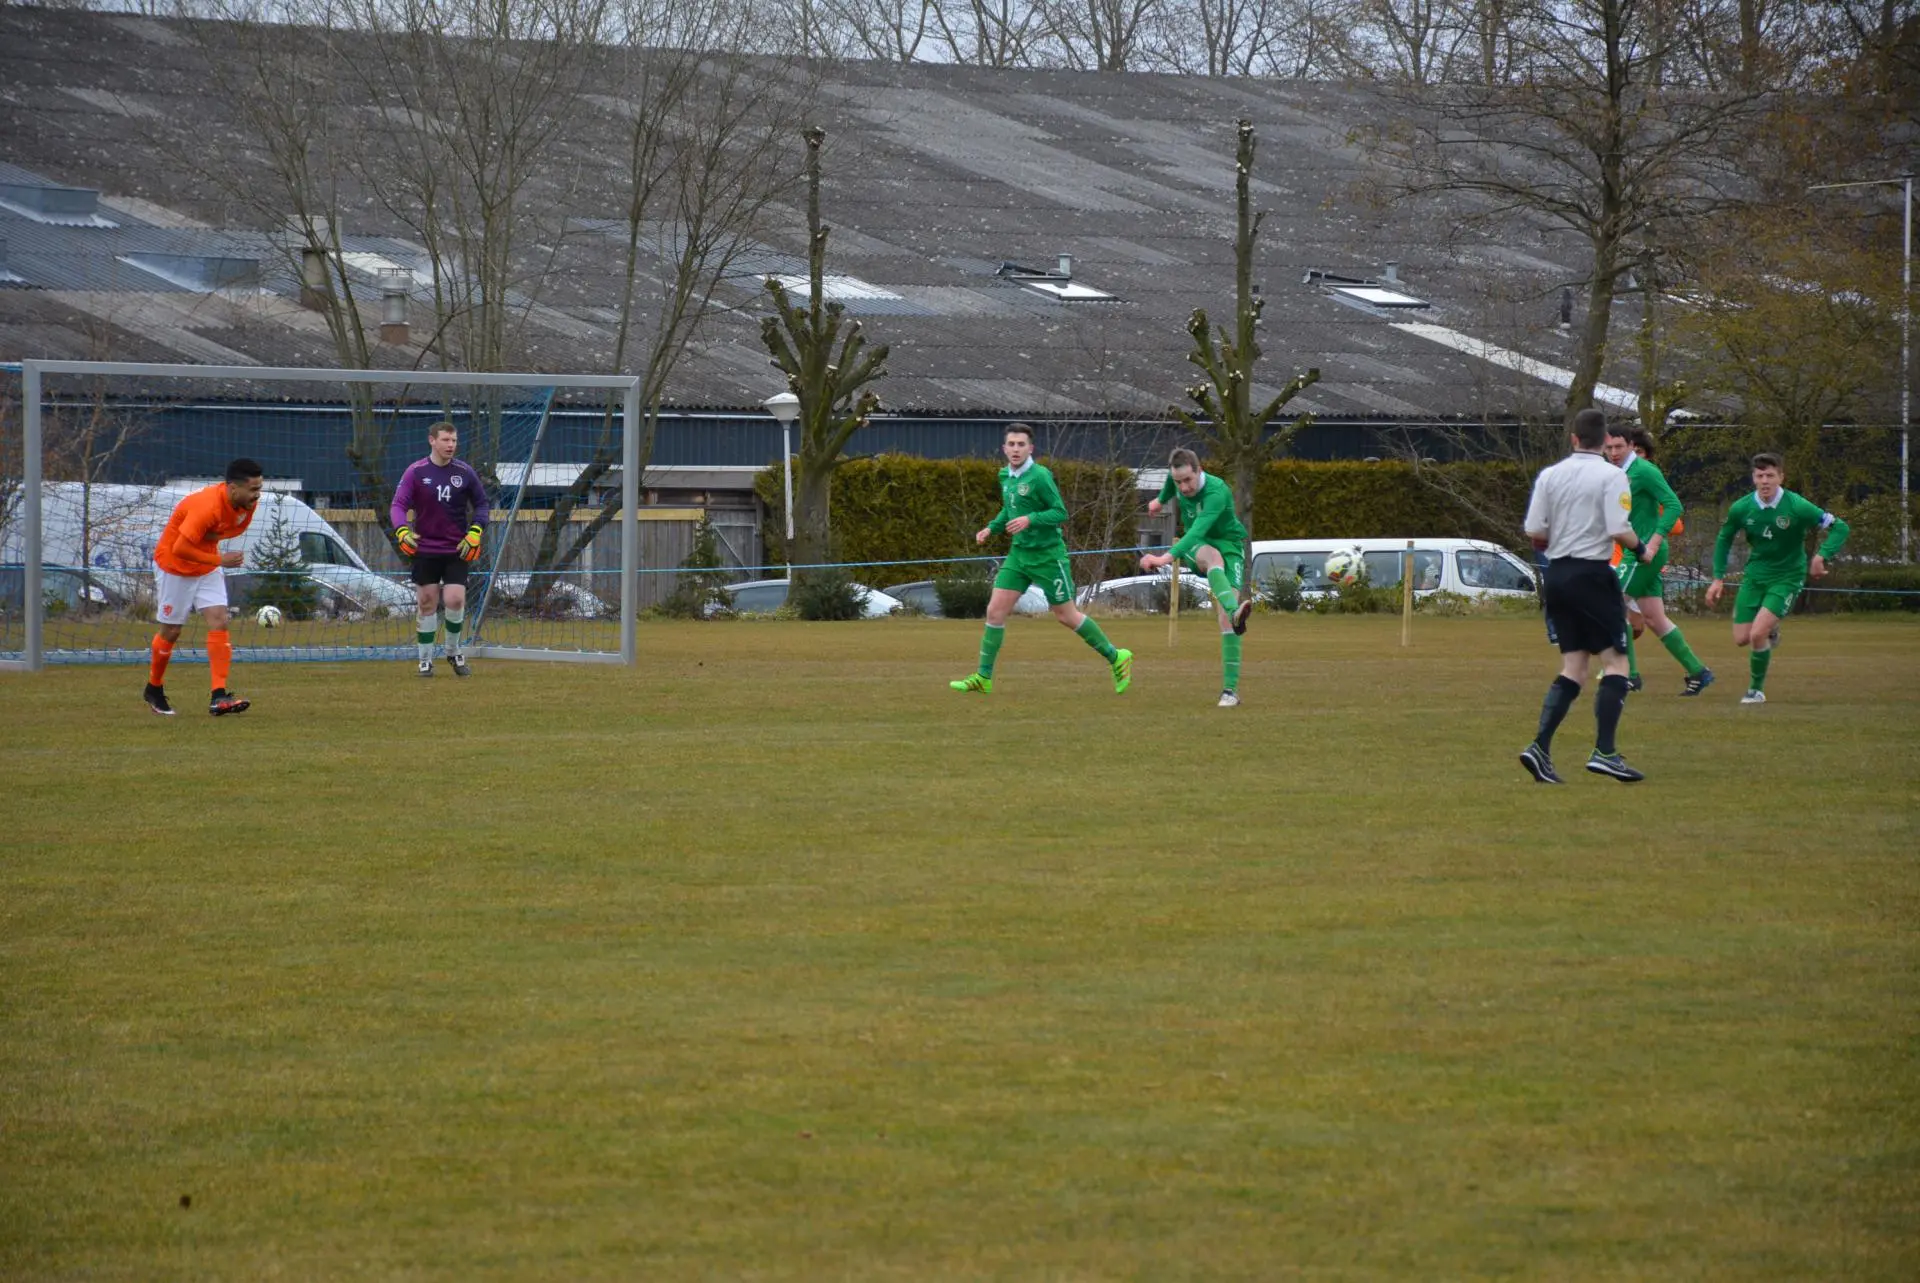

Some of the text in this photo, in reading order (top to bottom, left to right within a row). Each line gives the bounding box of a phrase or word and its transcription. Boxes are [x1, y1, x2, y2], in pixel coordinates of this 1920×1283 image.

[436, 484, 451, 502] 14
[1762, 525, 1773, 540] 4
[1053, 578, 1065, 595] 2
